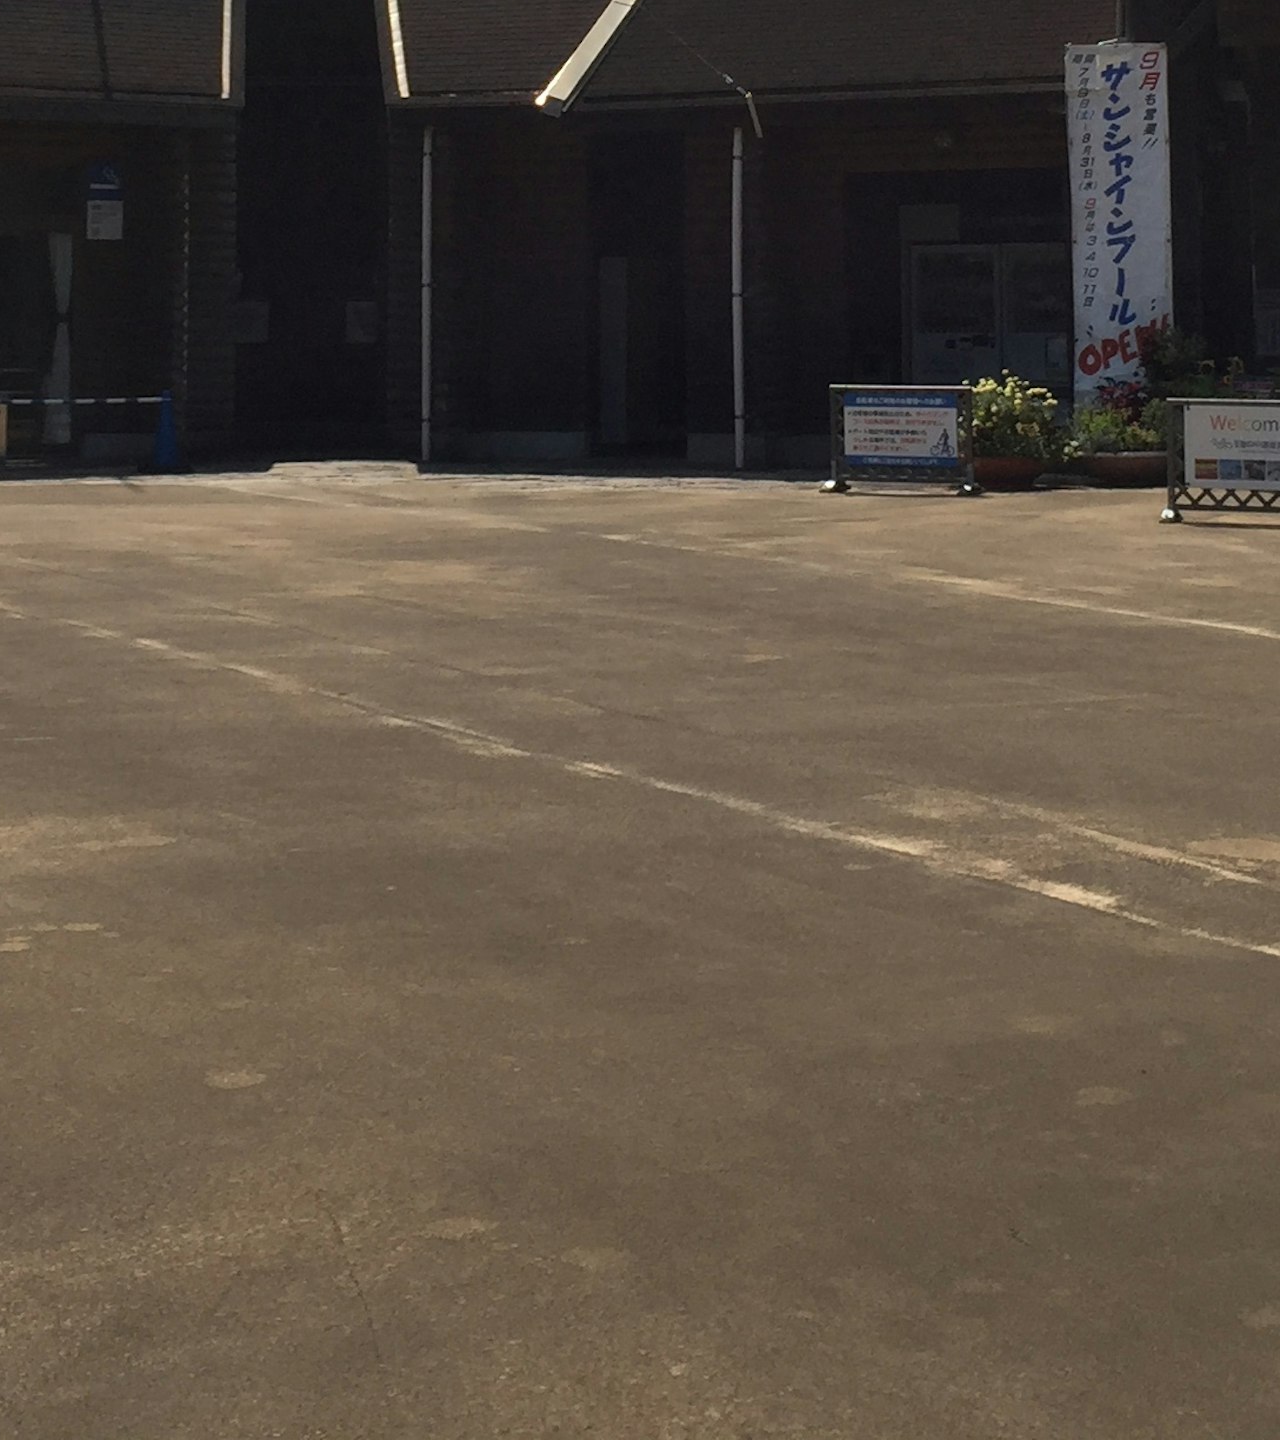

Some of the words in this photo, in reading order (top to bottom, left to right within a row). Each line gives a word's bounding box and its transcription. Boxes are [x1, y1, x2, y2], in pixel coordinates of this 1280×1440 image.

[1101, 61, 1137, 326] サンシャインプール
